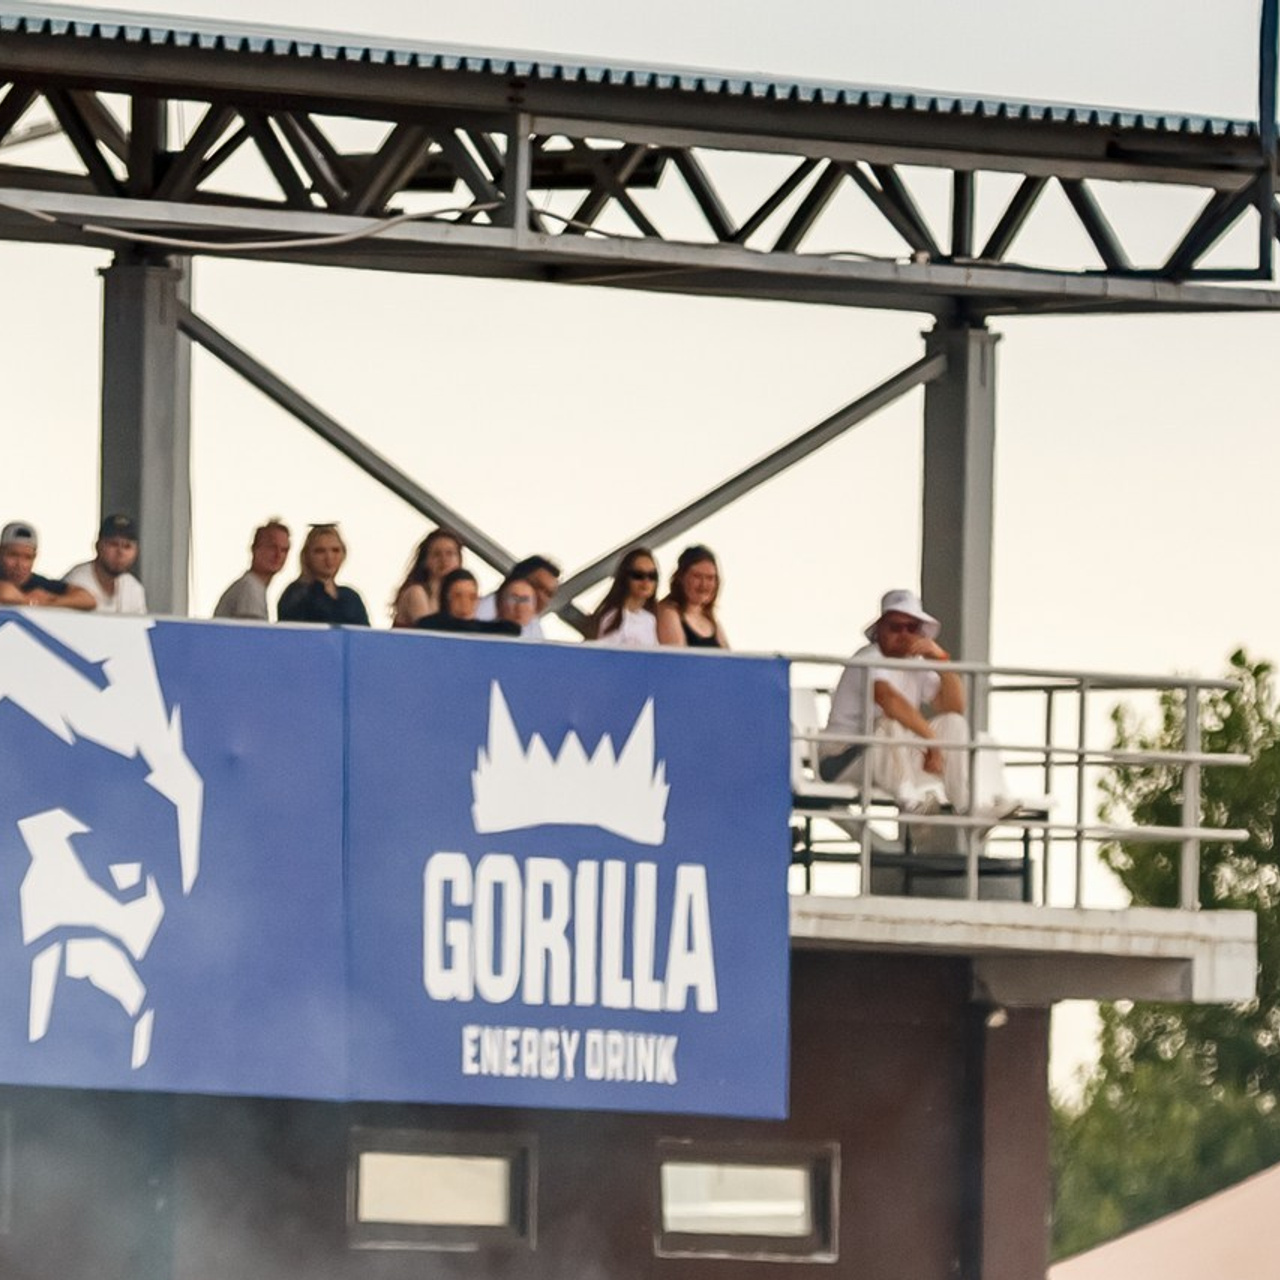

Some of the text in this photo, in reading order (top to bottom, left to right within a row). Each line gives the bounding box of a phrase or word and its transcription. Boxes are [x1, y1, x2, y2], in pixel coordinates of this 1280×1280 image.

[423, 852, 718, 1013] GORILLA
[462, 1024, 679, 1085] ENERGY DRINK
